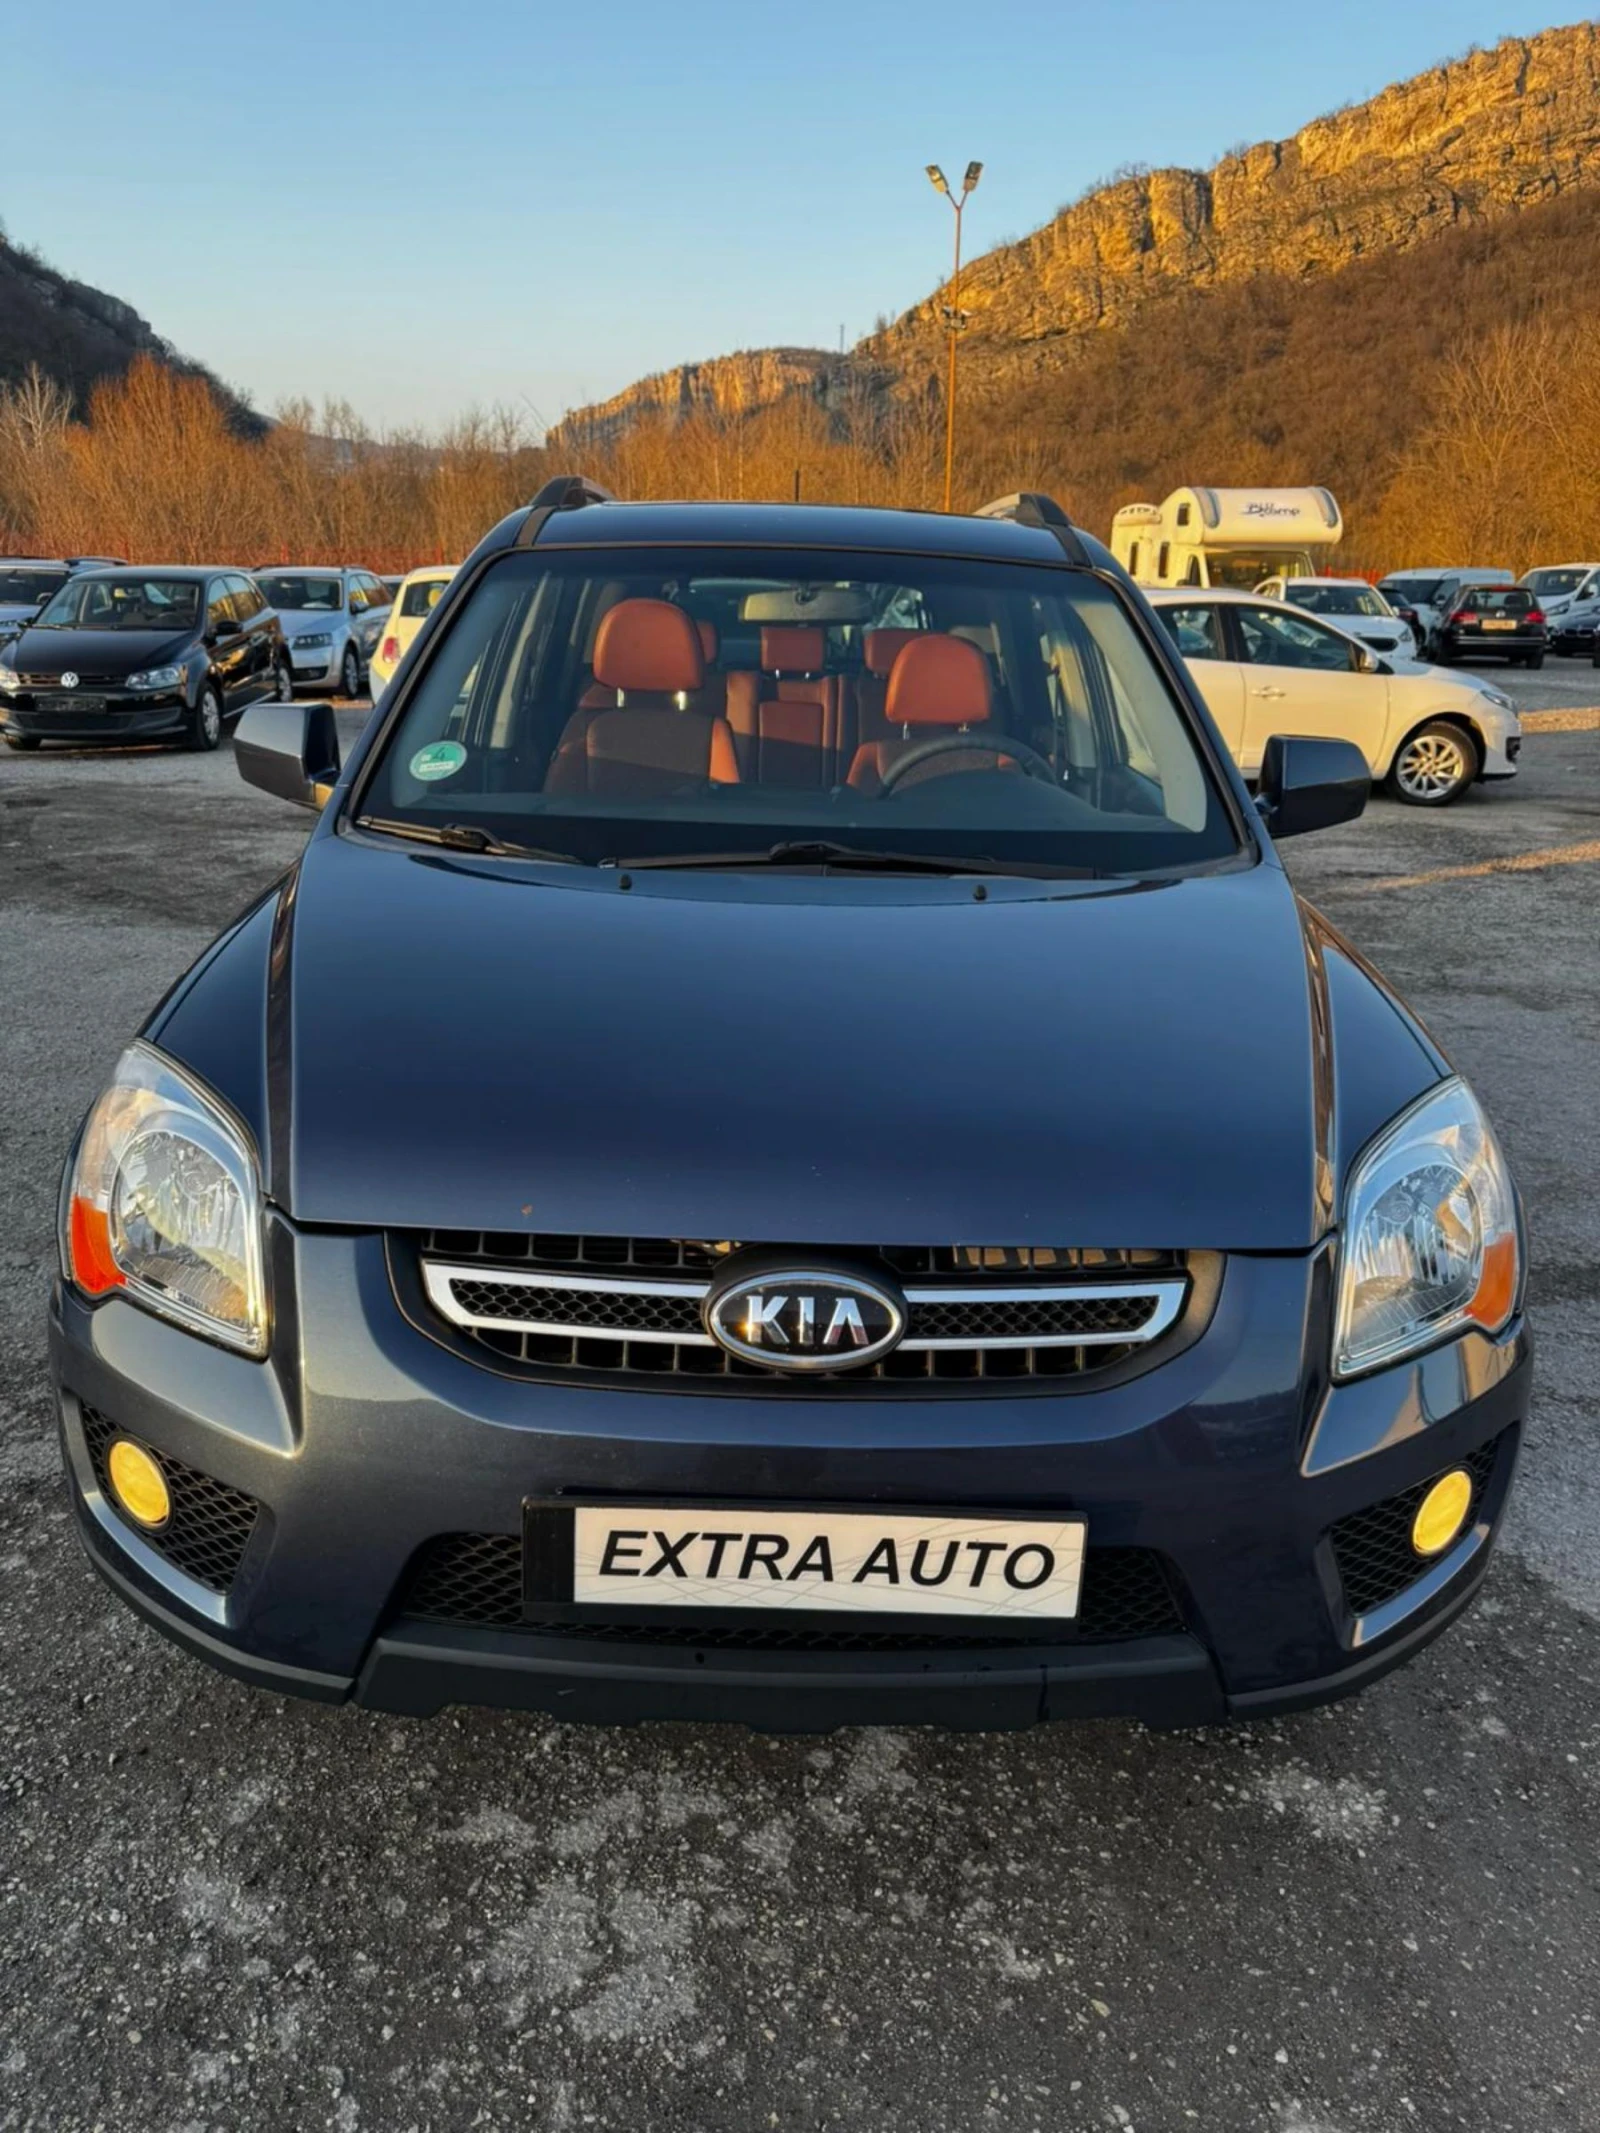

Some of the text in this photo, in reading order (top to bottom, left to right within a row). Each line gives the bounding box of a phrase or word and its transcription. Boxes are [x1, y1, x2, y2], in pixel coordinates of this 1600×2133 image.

[746, 1295, 869, 1345] KIA
[598, 1529, 1056, 1590] EXTRA AUTO
